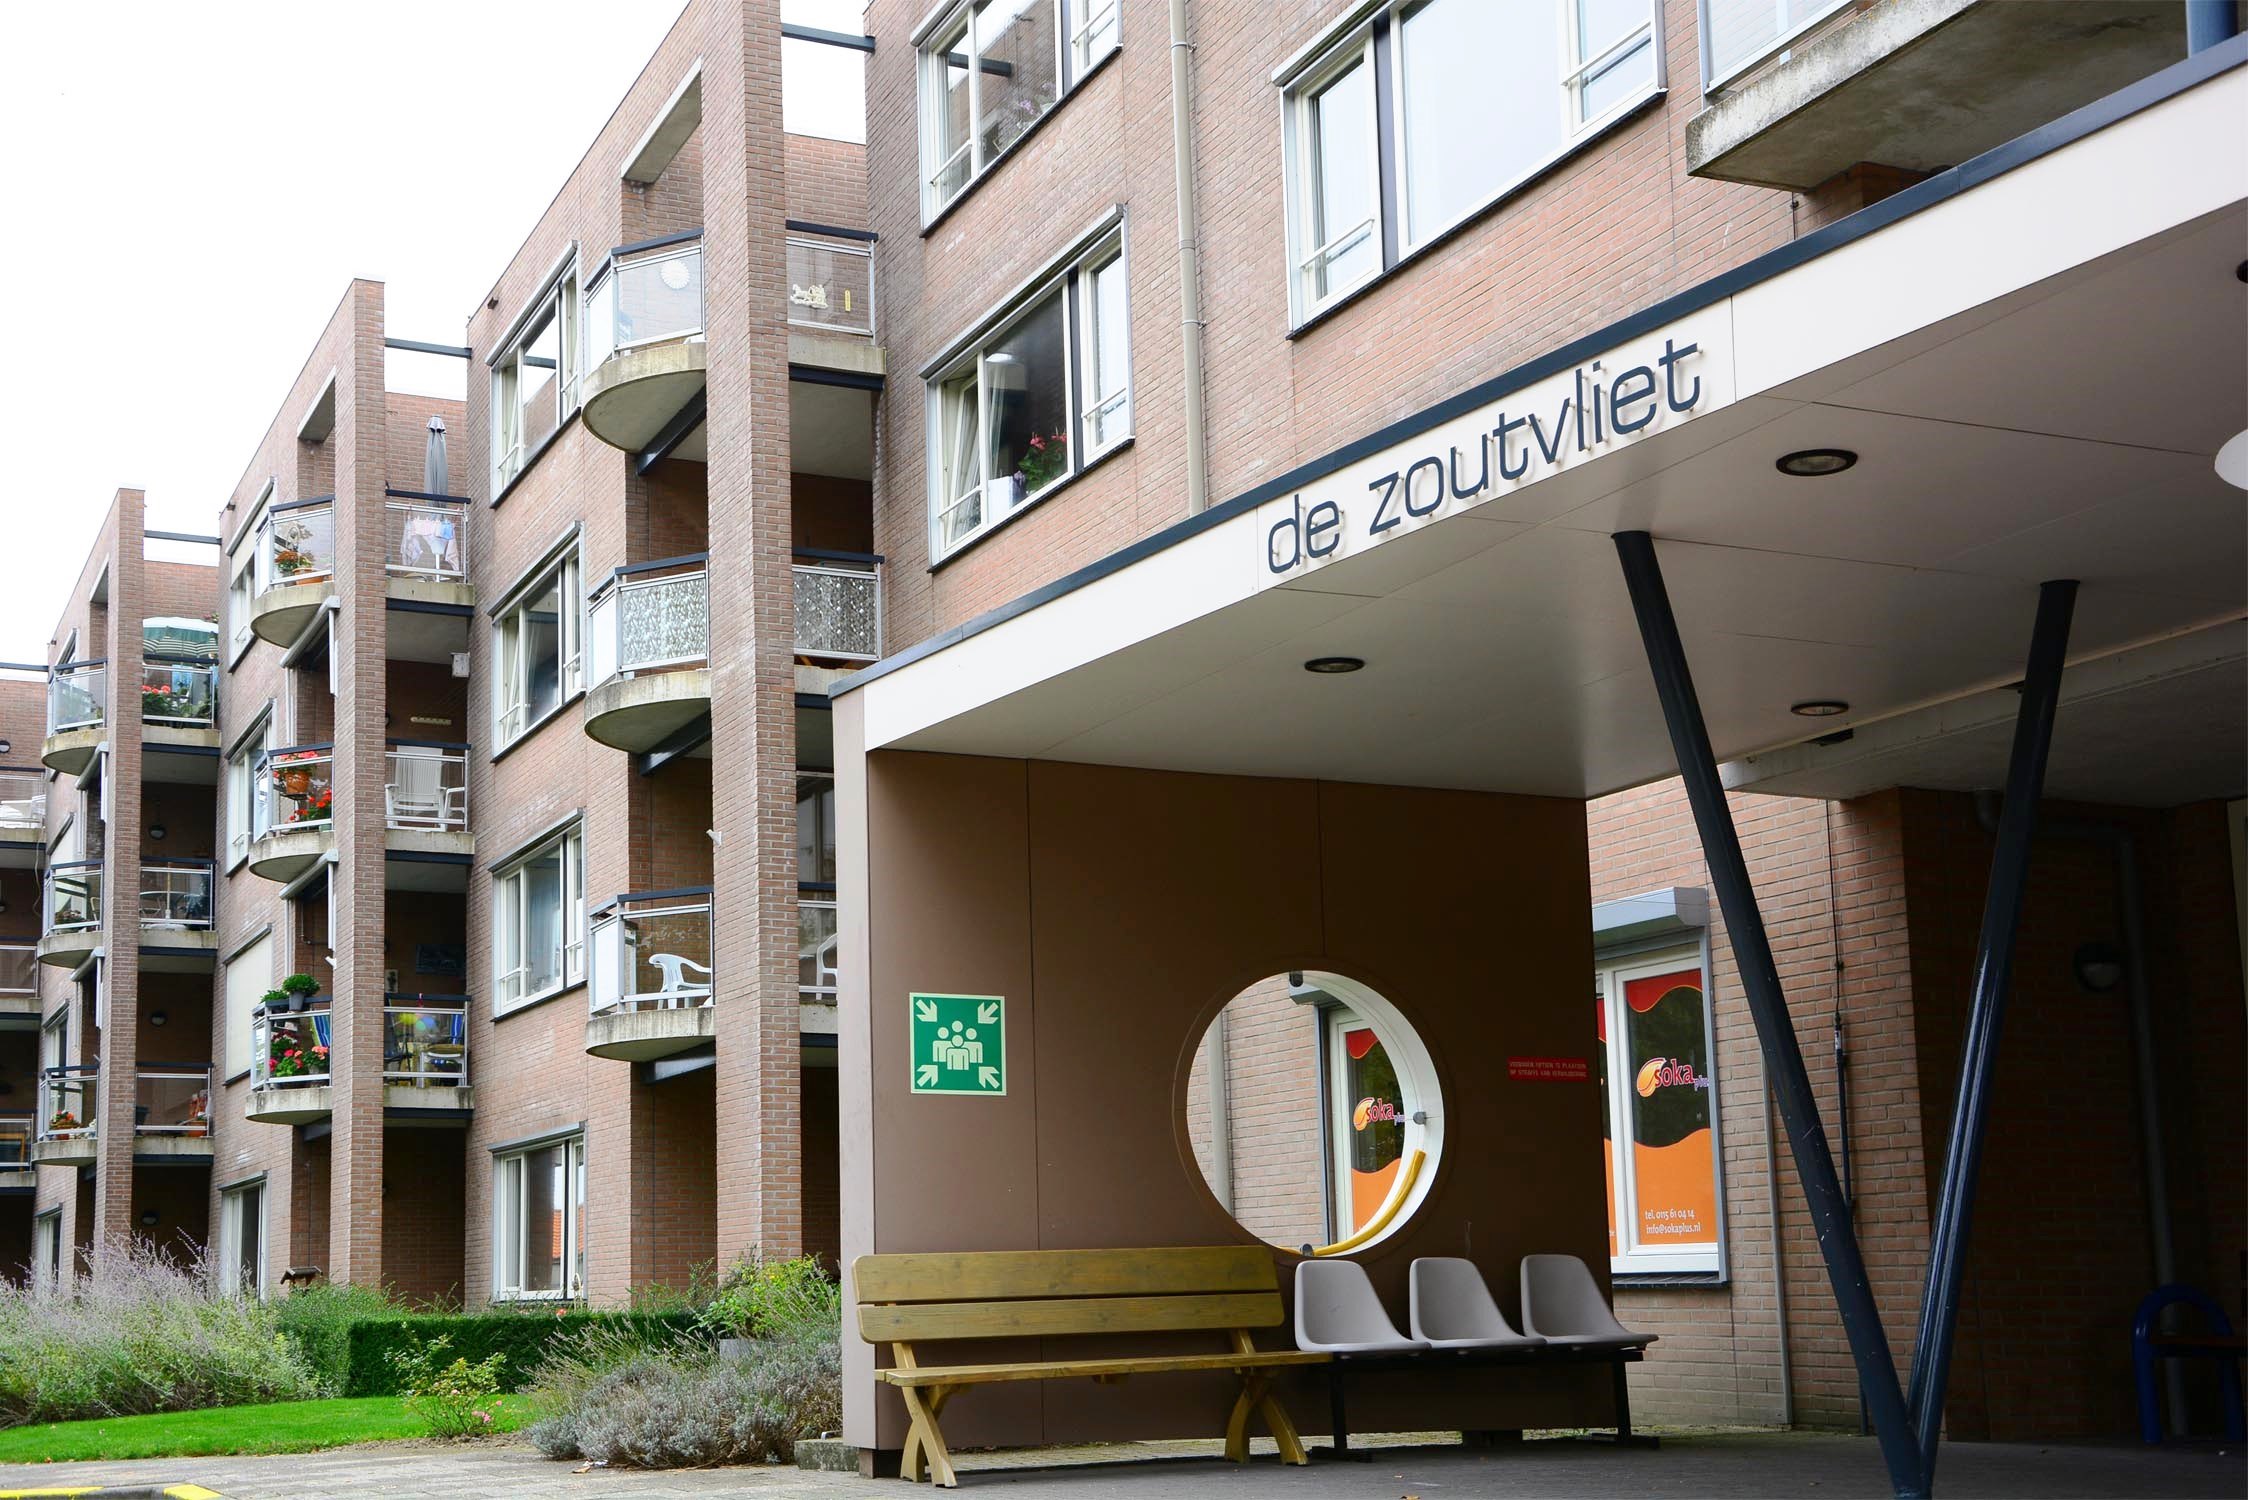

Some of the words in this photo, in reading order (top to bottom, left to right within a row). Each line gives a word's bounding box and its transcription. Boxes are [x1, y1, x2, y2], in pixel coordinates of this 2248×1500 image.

[1268, 494, 1340, 574] de
[1369, 338, 1701, 536] zoutvliet
[1654, 1058, 1695, 1088] soka
[1366, 1098, 1394, 1123] soka
[1646, 1222, 1701, 1236] info@sokaplus.nl
